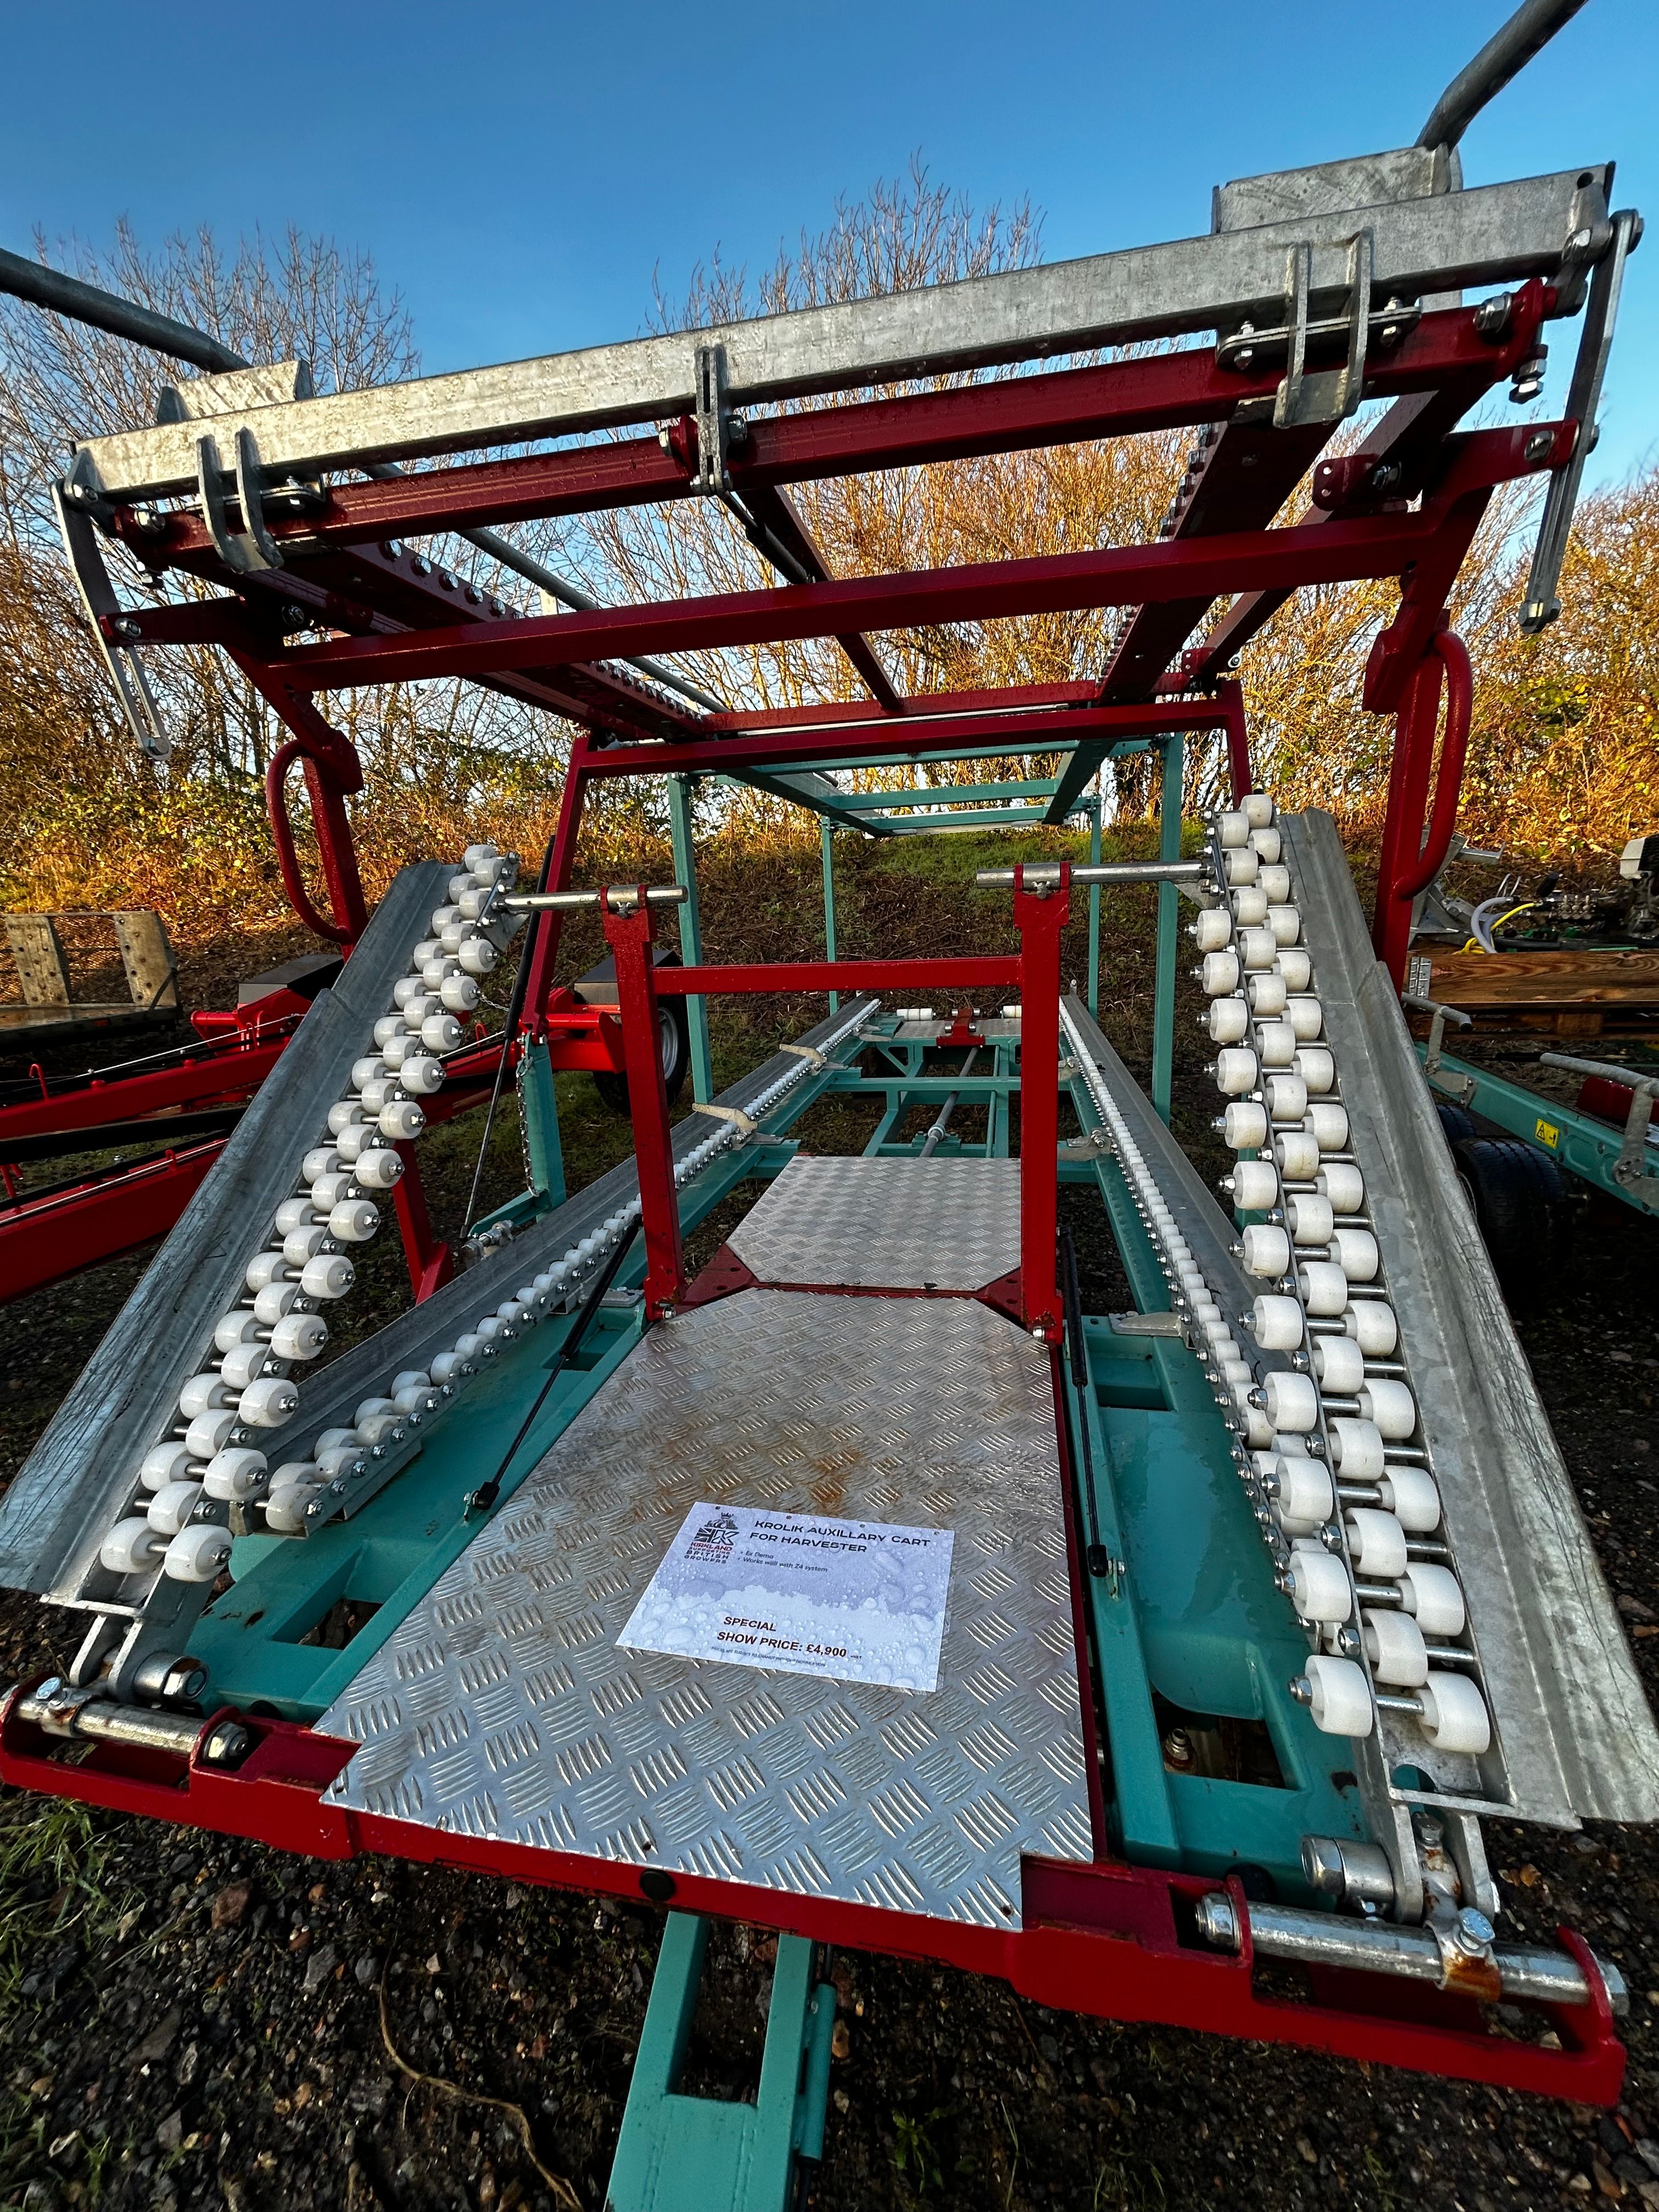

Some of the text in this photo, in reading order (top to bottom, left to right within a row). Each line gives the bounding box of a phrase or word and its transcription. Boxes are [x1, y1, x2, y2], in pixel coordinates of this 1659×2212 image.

[755, 1520, 930, 1546] KROLIK AUXILLARY CART
[691, 1542, 732, 1551] KIRKLAND
[750, 1532, 867, 1552] FOR HARVESTER
[684, 1555, 726, 1564] GROWERS
[686, 1550, 729, 1559] BRITISH
[724, 1616, 776, 1632] SPECIAL
[717, 1632, 758, 1644] SHOW
[759, 1638, 803, 1651] PRICE:
[806, 1644, 847, 1657] £4,900
